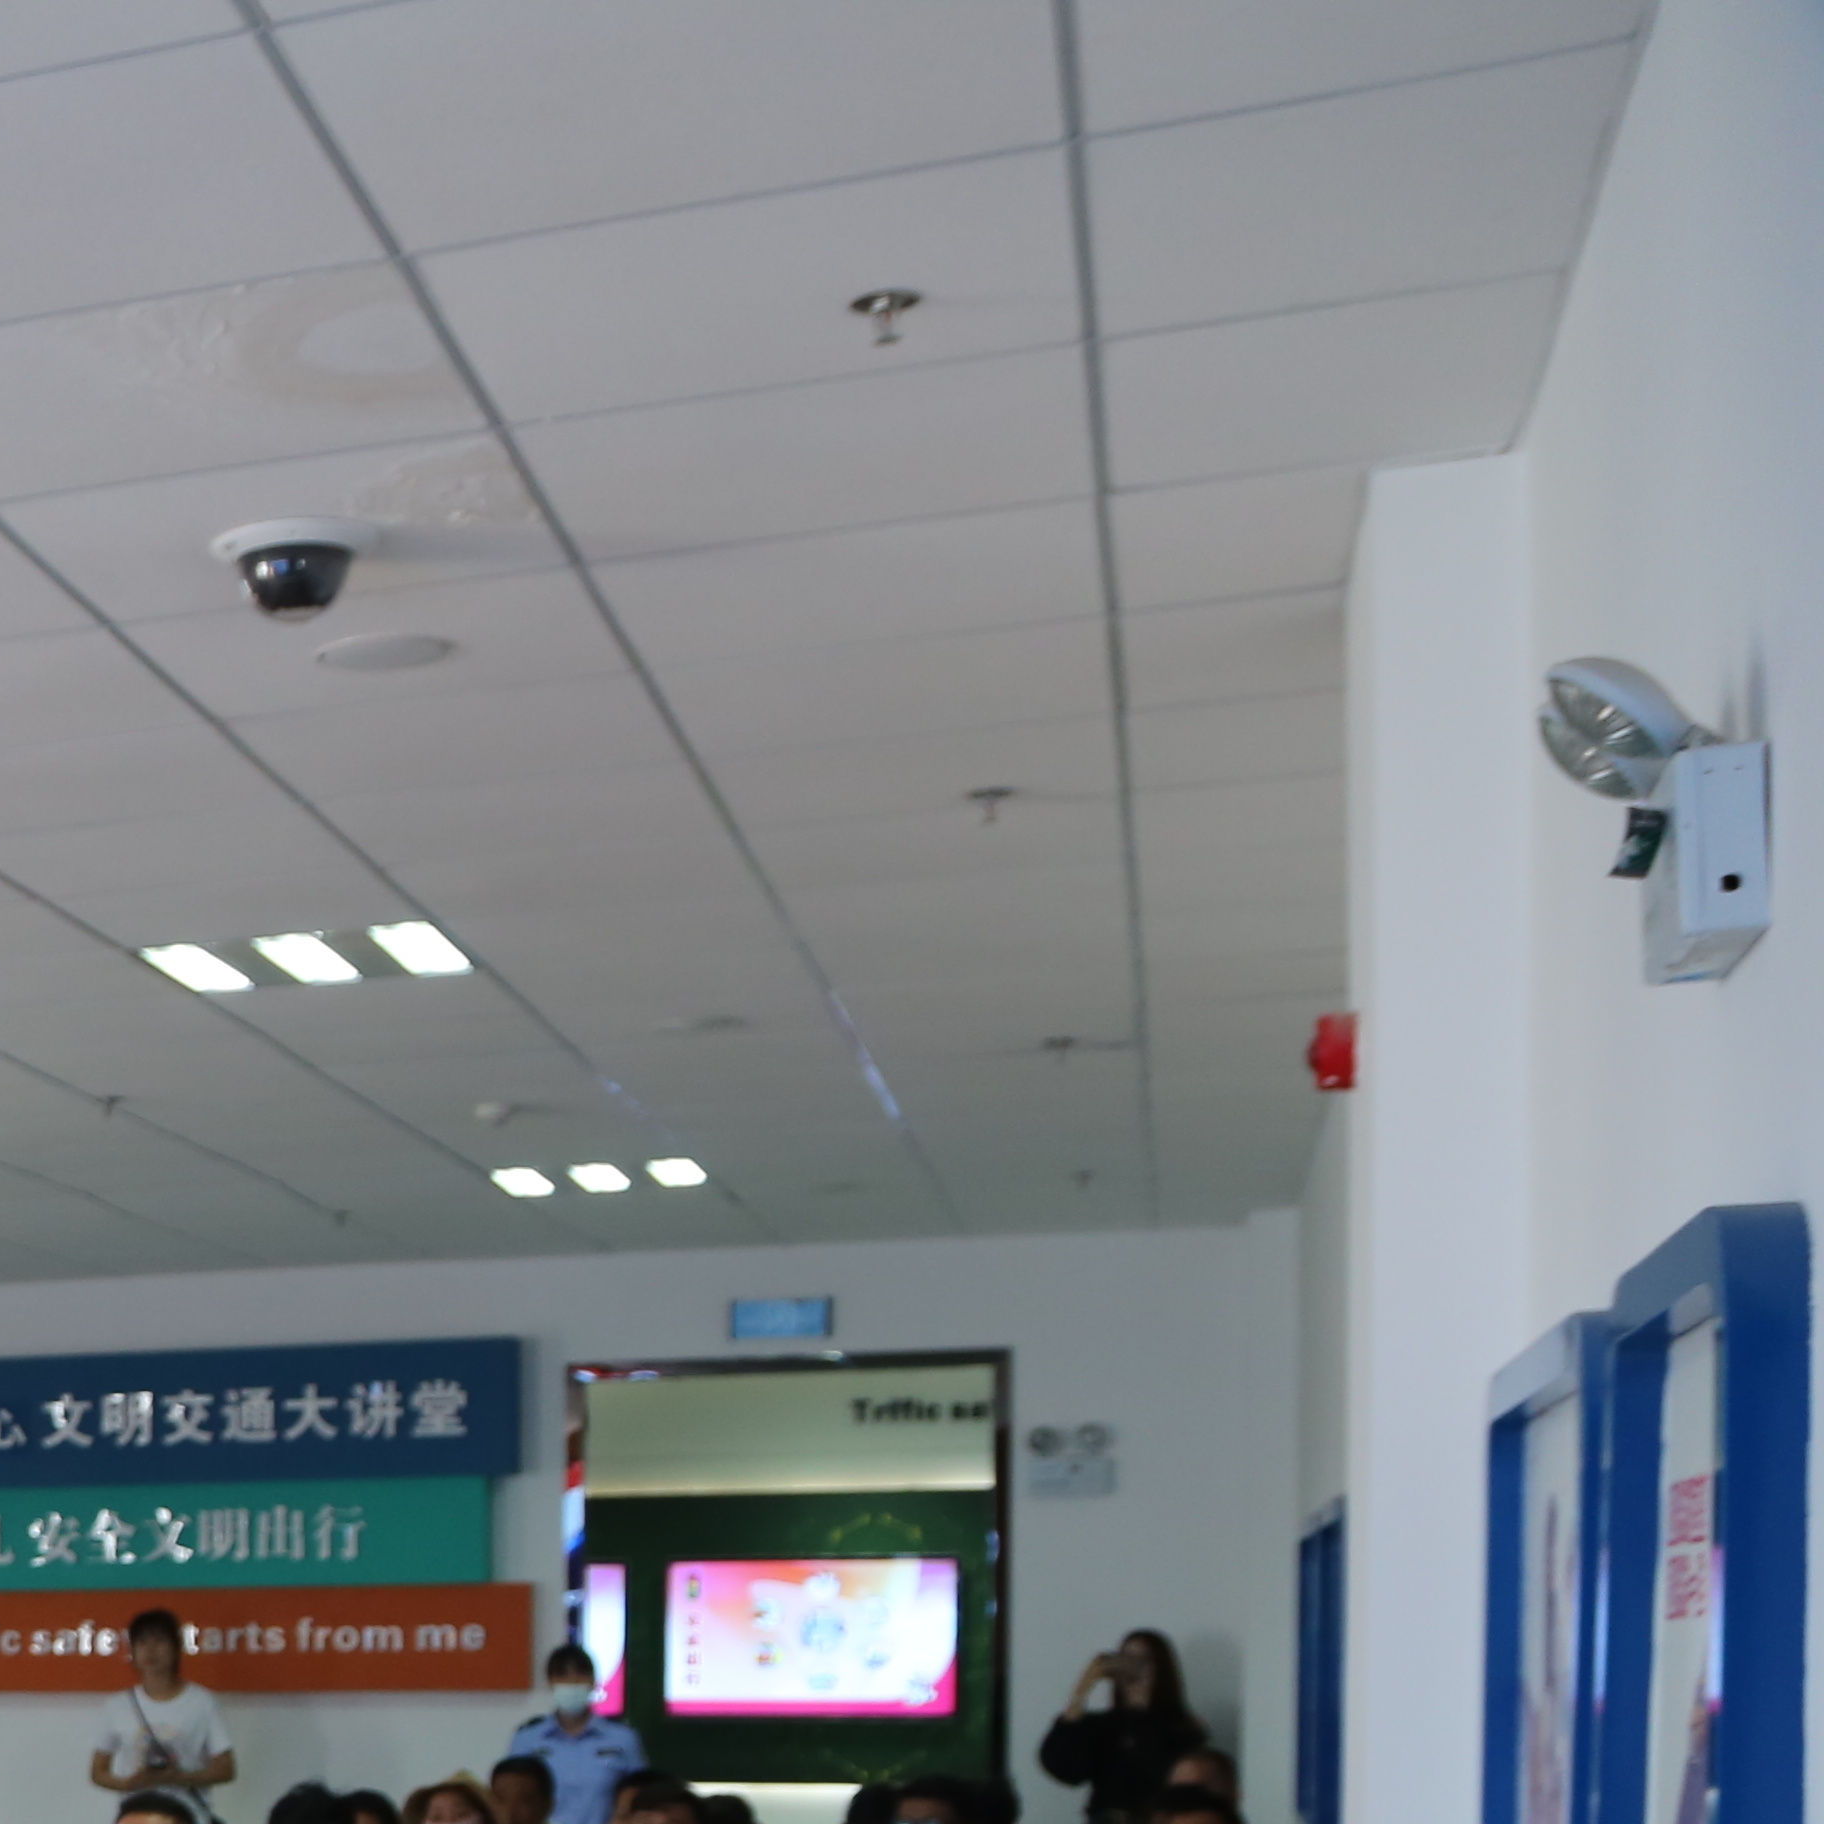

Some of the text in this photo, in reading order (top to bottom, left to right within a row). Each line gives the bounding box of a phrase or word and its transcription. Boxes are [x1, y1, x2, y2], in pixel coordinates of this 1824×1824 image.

[28, 1618, 134, 1664] safe
[180, 1619, 288, 1656] tarts
[295, 1615, 406, 1655] from
[413, 1620, 488, 1653] me
